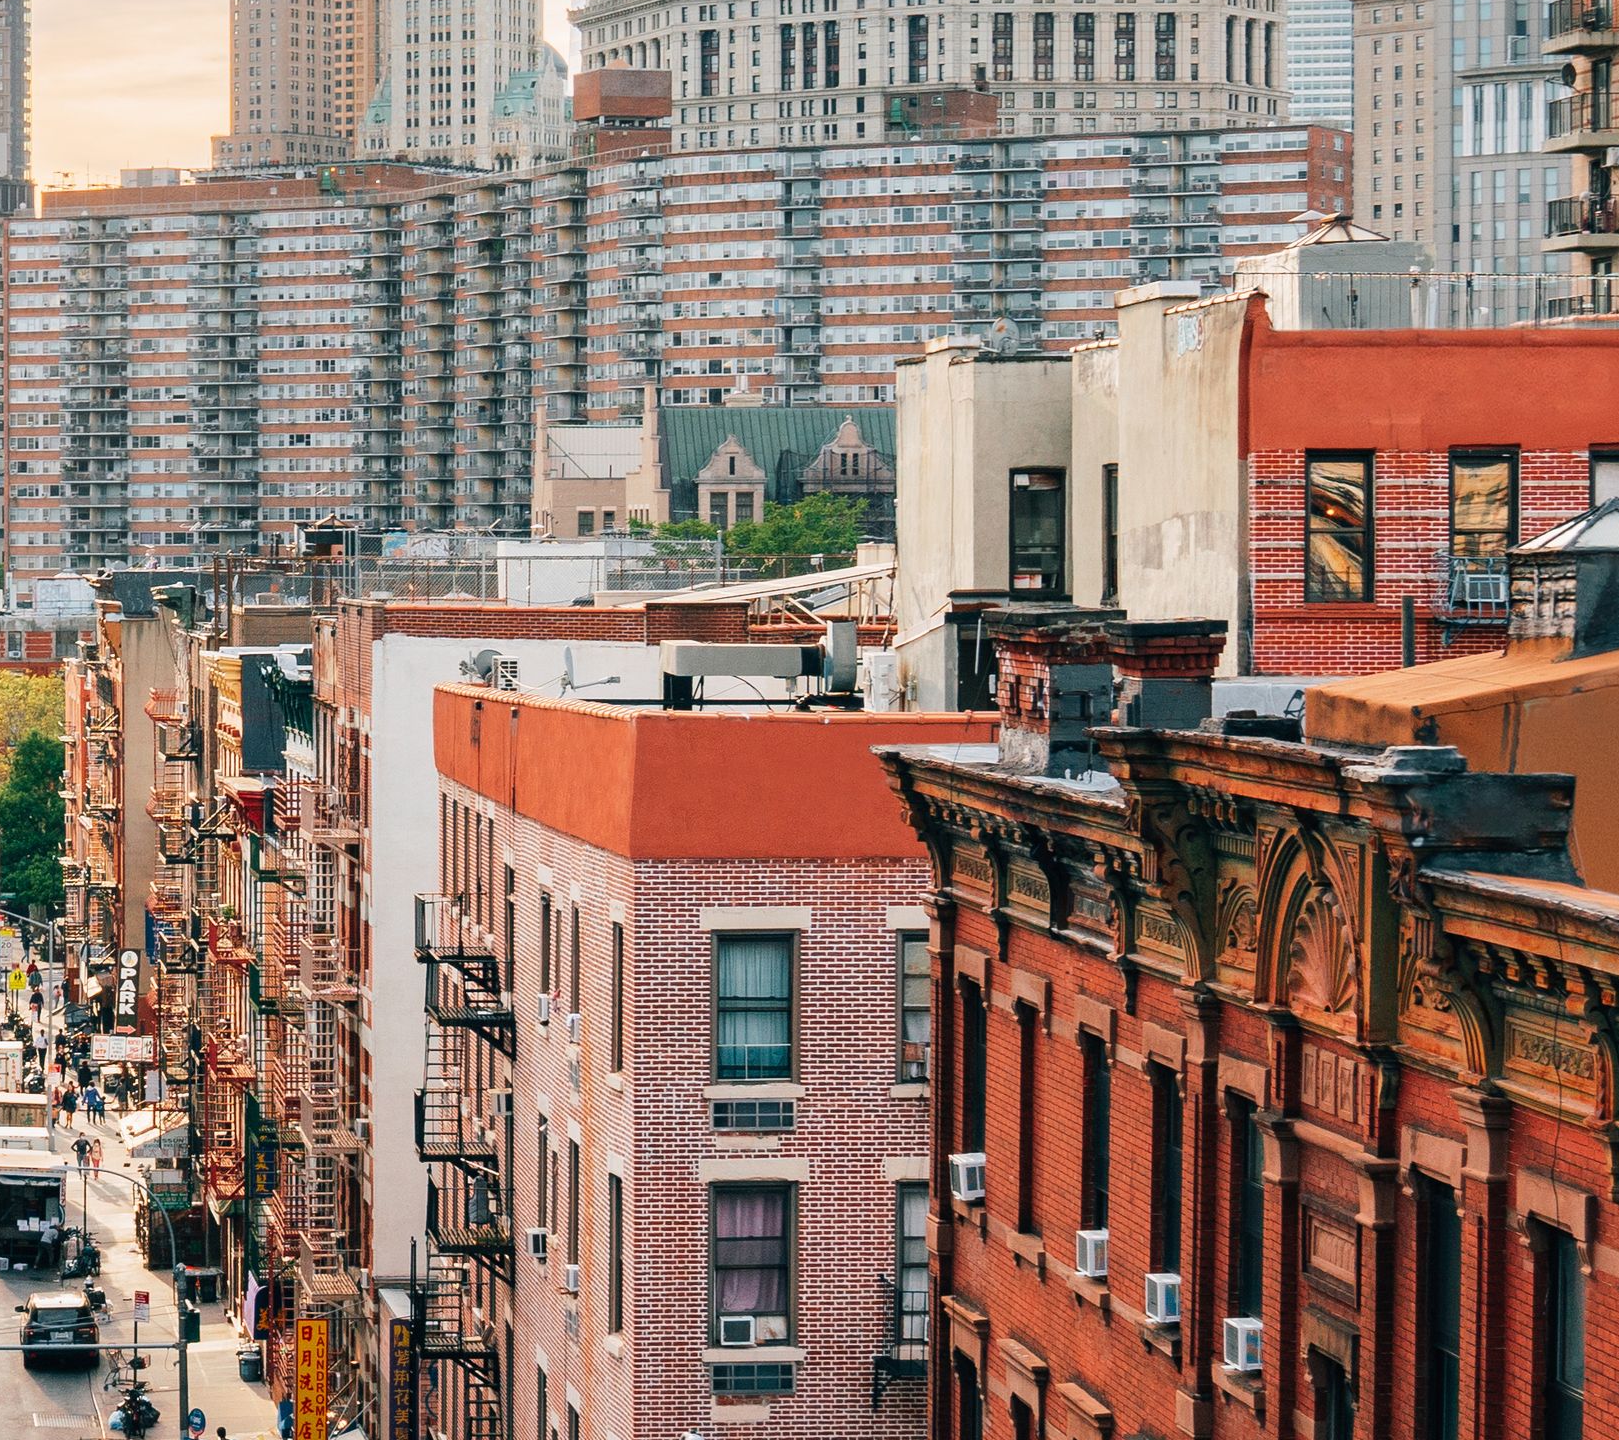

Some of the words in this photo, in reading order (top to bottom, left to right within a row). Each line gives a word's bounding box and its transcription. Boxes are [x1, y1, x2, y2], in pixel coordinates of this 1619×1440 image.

[118, 968, 137, 1015] PARK
[298, 1325, 314, 1440] 日月洗衣店
[315, 1325, 326, 1439] LAUNDROMAT
